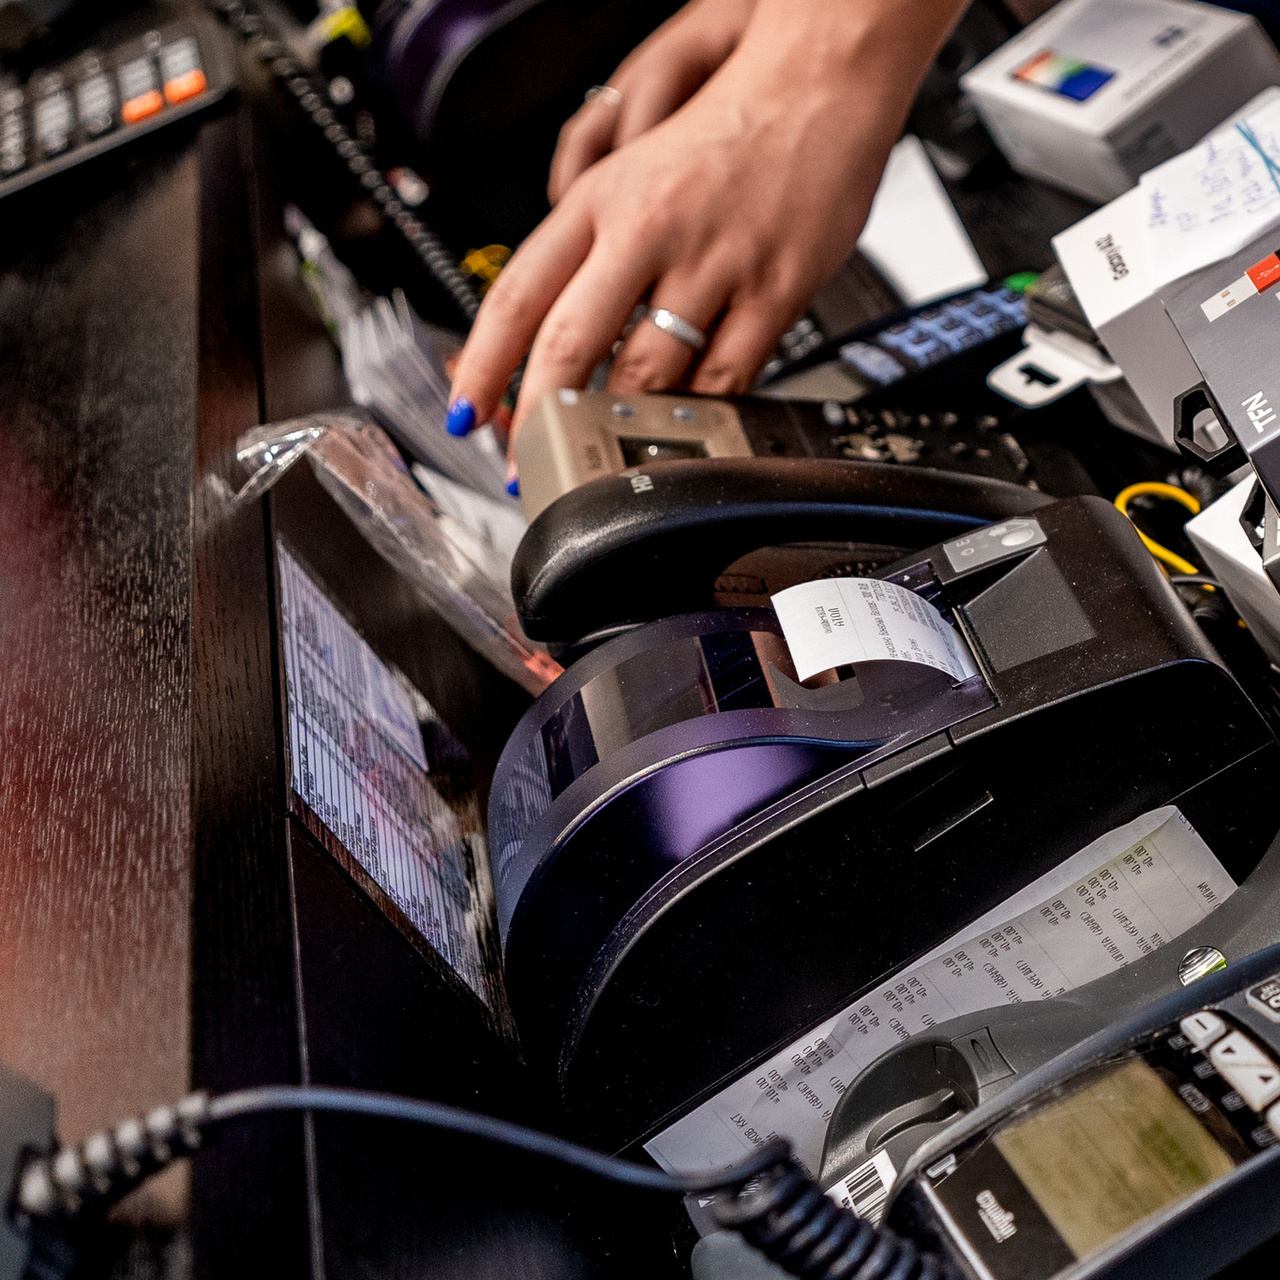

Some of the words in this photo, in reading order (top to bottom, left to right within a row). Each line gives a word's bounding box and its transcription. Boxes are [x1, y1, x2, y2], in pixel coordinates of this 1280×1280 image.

[1242, 391, 1277, 433] TFN
[828, 607, 845, 627] АТОЛ
[1196, 881, 1218, 905] ТИПАМ
[1079, 911, 1104, 937] (АВАНС)
[1101, 935, 1126, 963] ОПЛАТА
[982, 962, 1009, 990] (АВАНС)
[729, 1113, 748, 1129] ККТ
